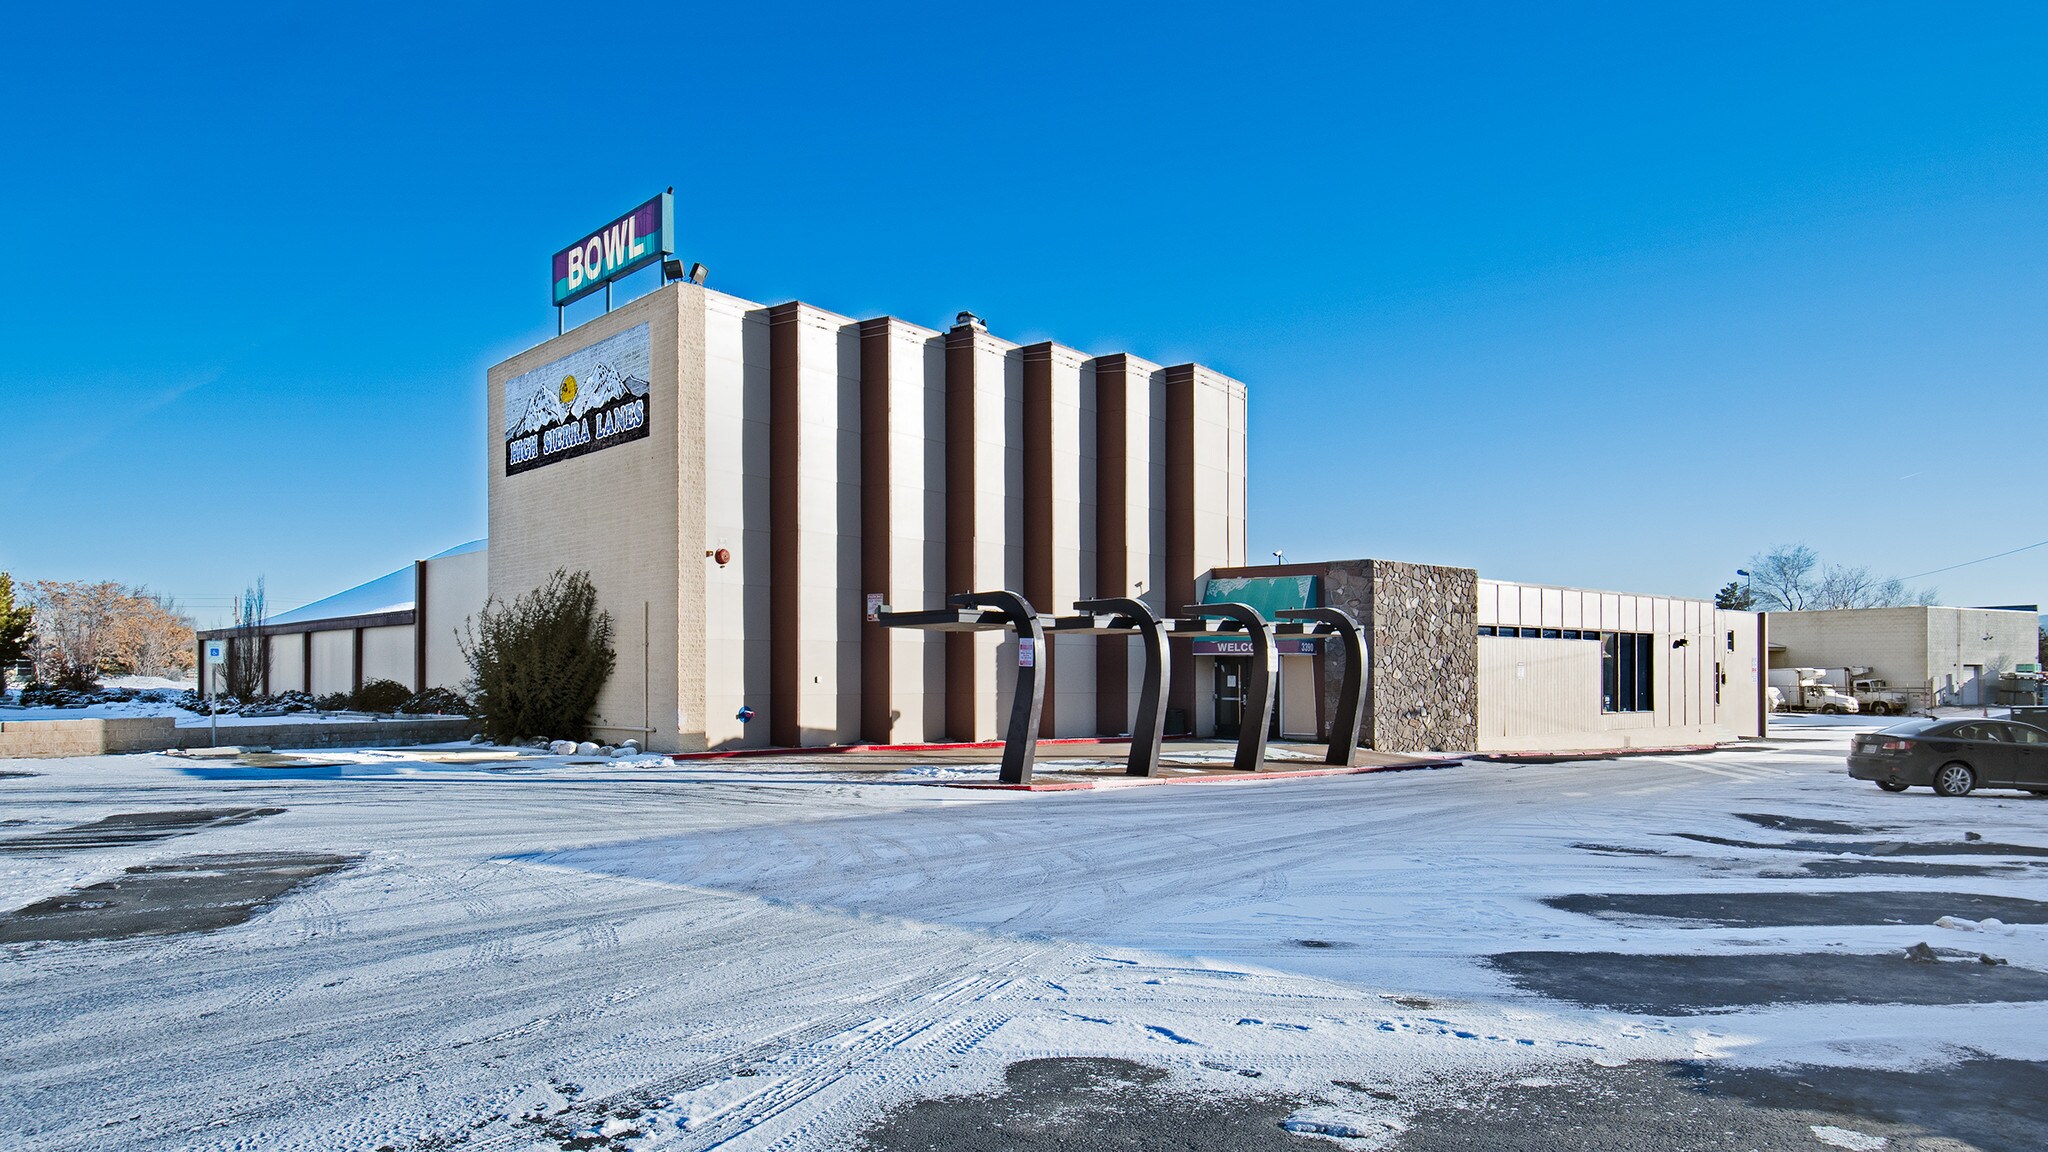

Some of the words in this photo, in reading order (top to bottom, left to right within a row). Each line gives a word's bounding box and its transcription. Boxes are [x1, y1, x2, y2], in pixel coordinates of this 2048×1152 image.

[568, 215, 644, 290] BOWL
[510, 434, 538, 465] HIGH
[543, 418, 590, 455] SIERRA
[596, 399, 644, 439] LANES
